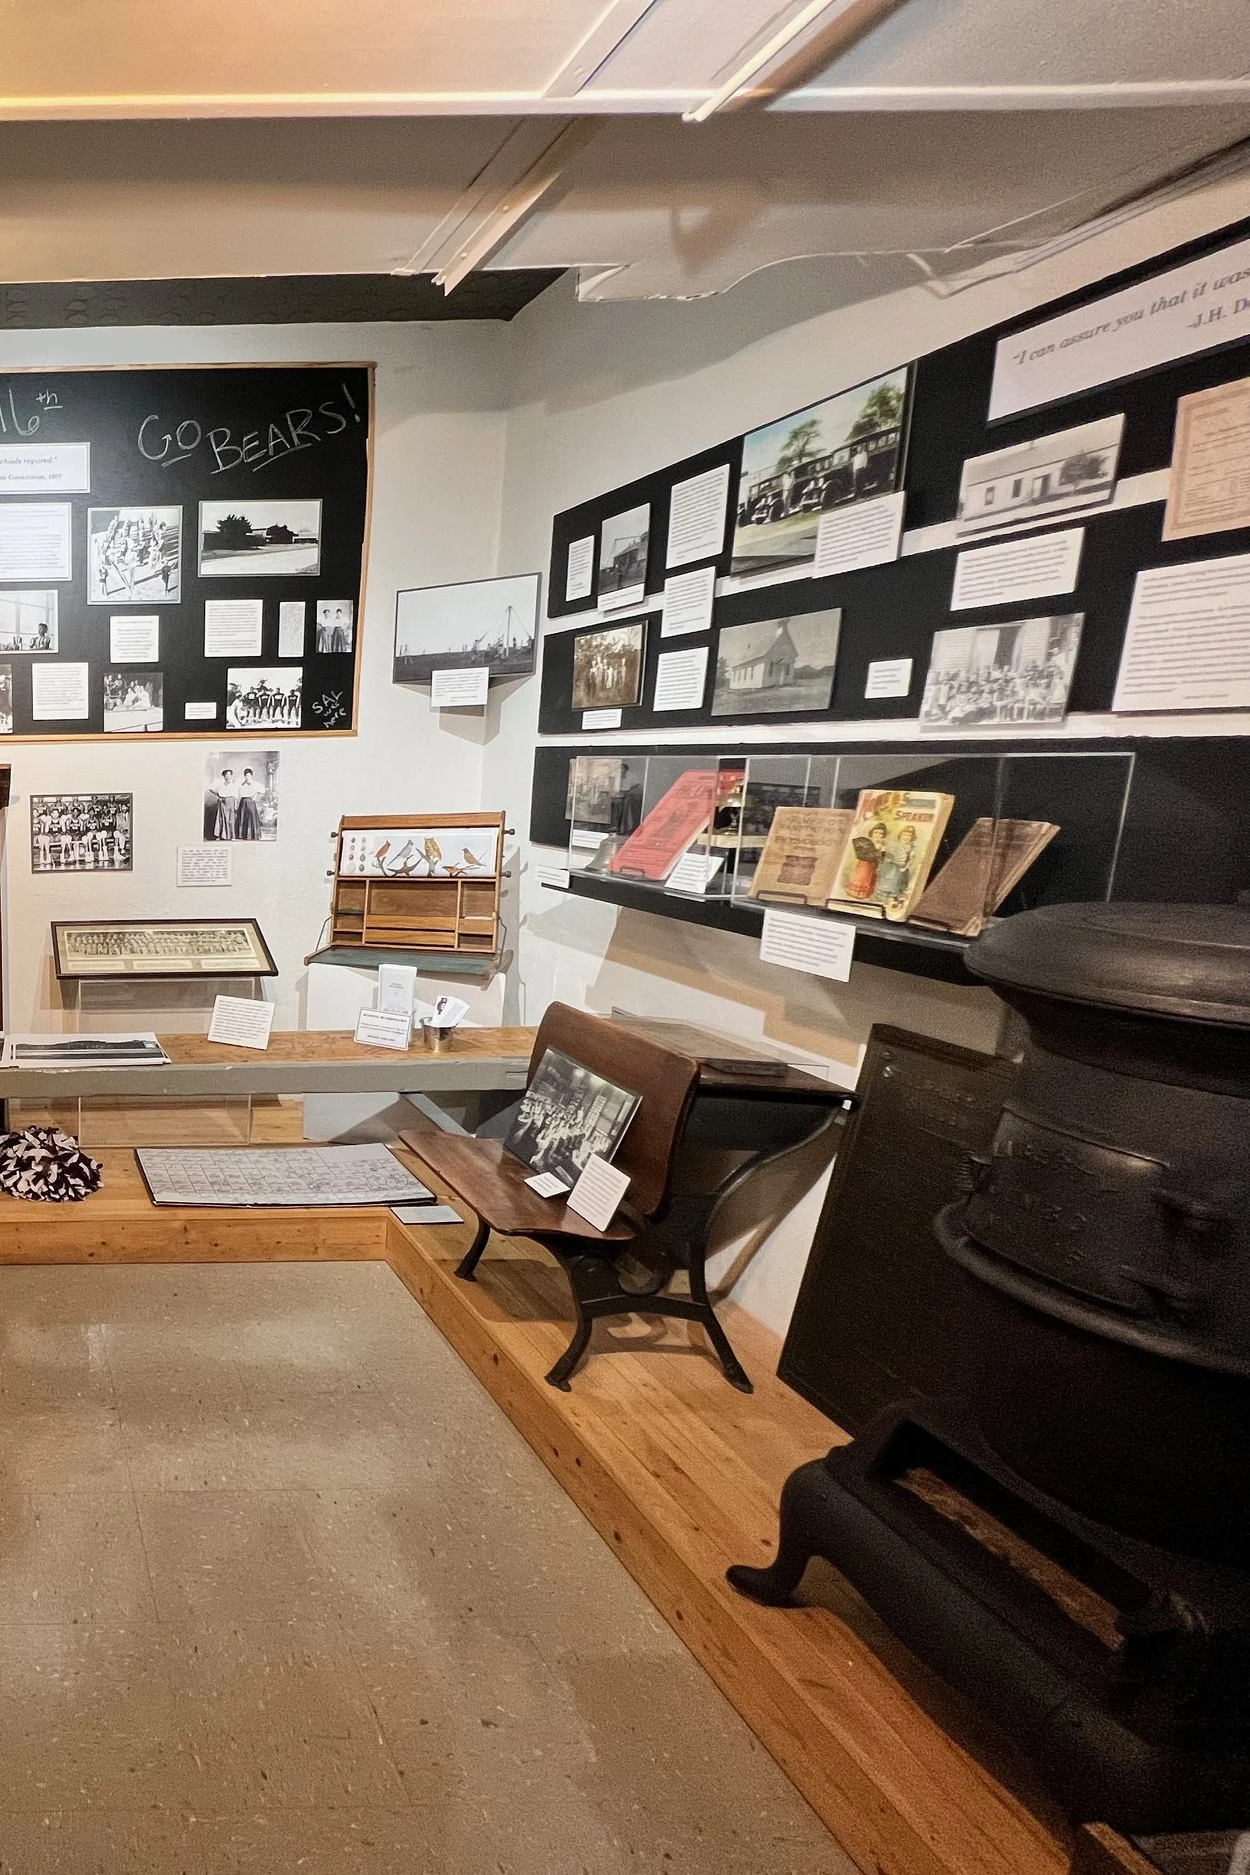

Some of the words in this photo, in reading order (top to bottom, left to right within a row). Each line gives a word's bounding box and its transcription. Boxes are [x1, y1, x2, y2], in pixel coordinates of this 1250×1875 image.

[1029, 344, 1055, 361] can
[1059, 322, 1111, 349] assure
[1112, 309, 1144, 333] you
[1149, 291, 1186, 316] that
[1192, 282, 1207, 299] it
[1213, 268, 1250, 291] was
[138, 415, 201, 463] GO
[206, 382, 360, 475] BEARS!
[312, 690, 344, 714] SAY
[323, 707, 347, 728] here
